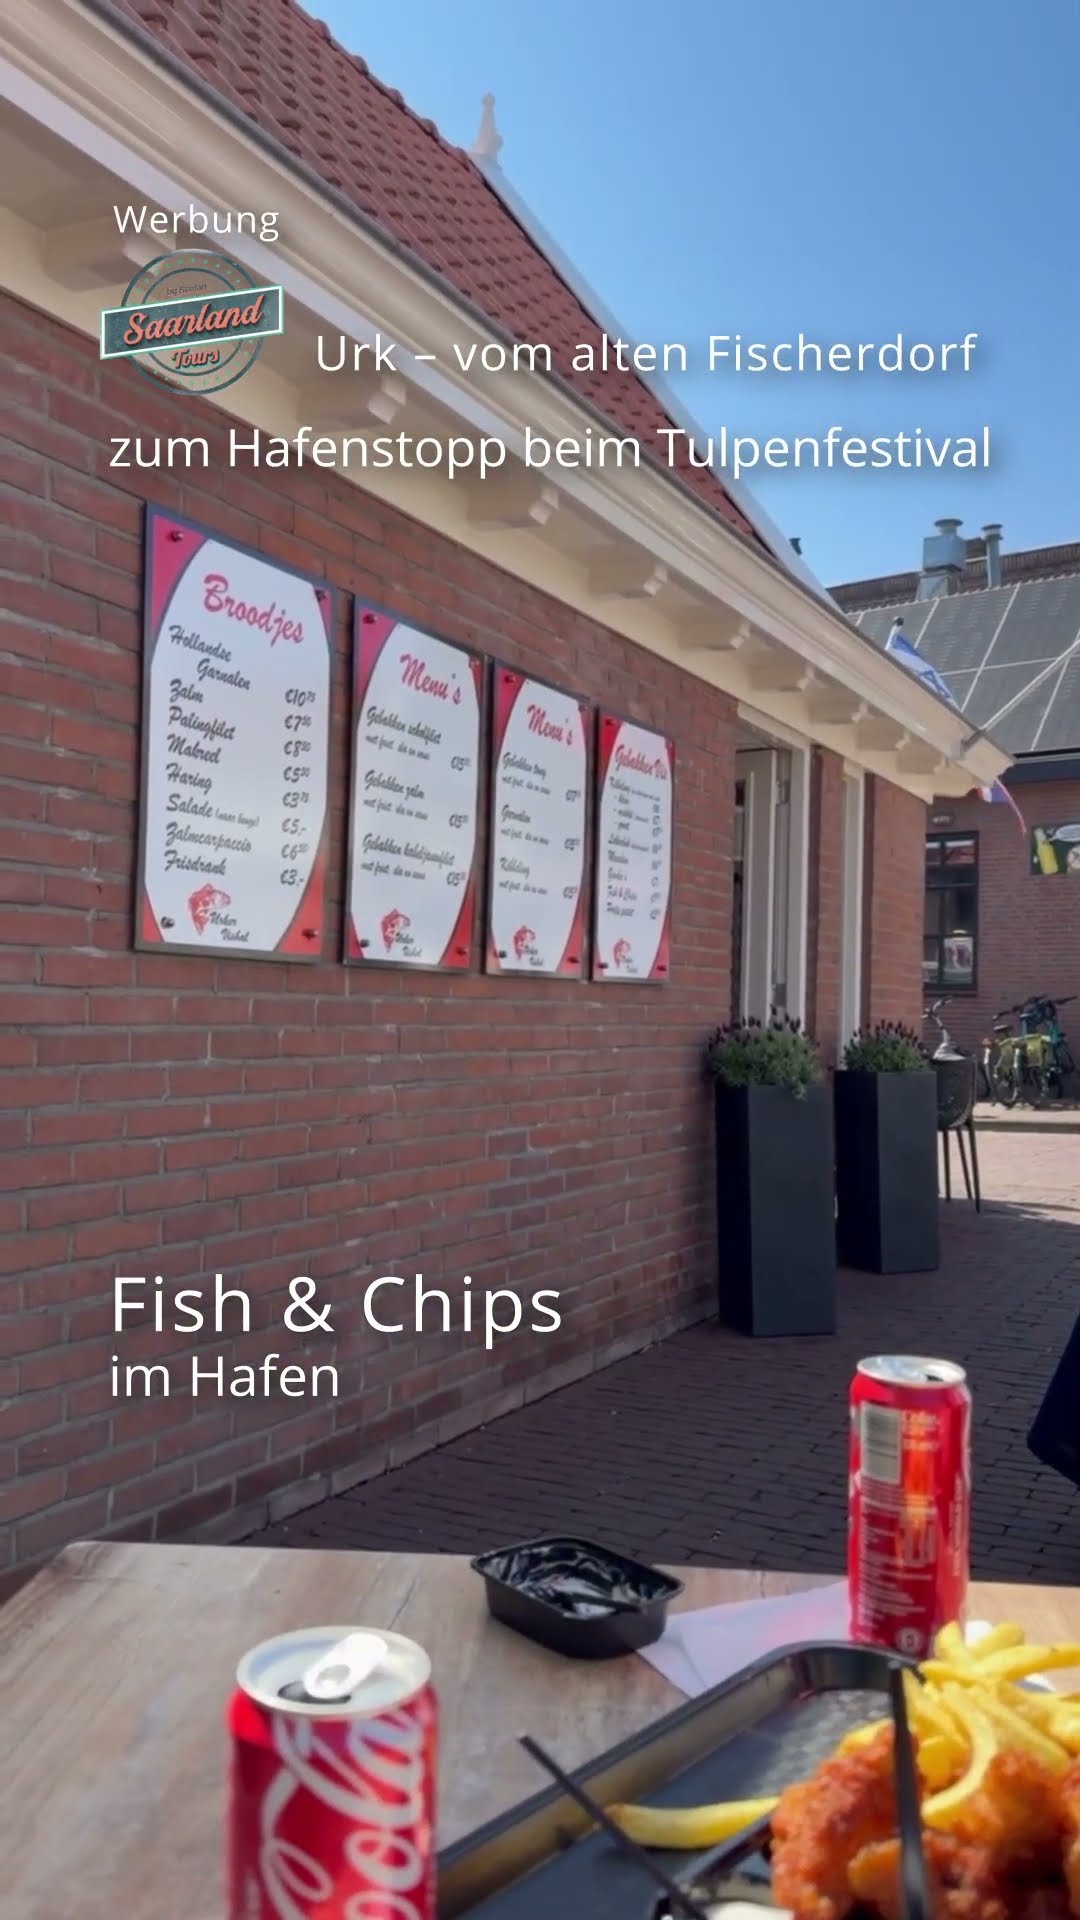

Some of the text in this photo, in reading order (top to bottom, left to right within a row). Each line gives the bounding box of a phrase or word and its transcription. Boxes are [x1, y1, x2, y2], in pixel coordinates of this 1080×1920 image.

[203, 573, 304, 647] Broodjes
[169, 624, 232, 663] Hollandse
[196, 658, 251, 690] Garnalen
[400, 653, 462, 705] Menu's
[169, 678, 204, 704] Zalm
[168, 705, 236, 742] Palingfilet
[527, 704, 573, 746] Menu's
[166, 762, 212, 795] Haring
[166, 793, 213, 819] Salade
[165, 821, 252, 853] Zalmcarpaccio
[164, 849, 228, 876] Frisdrank
